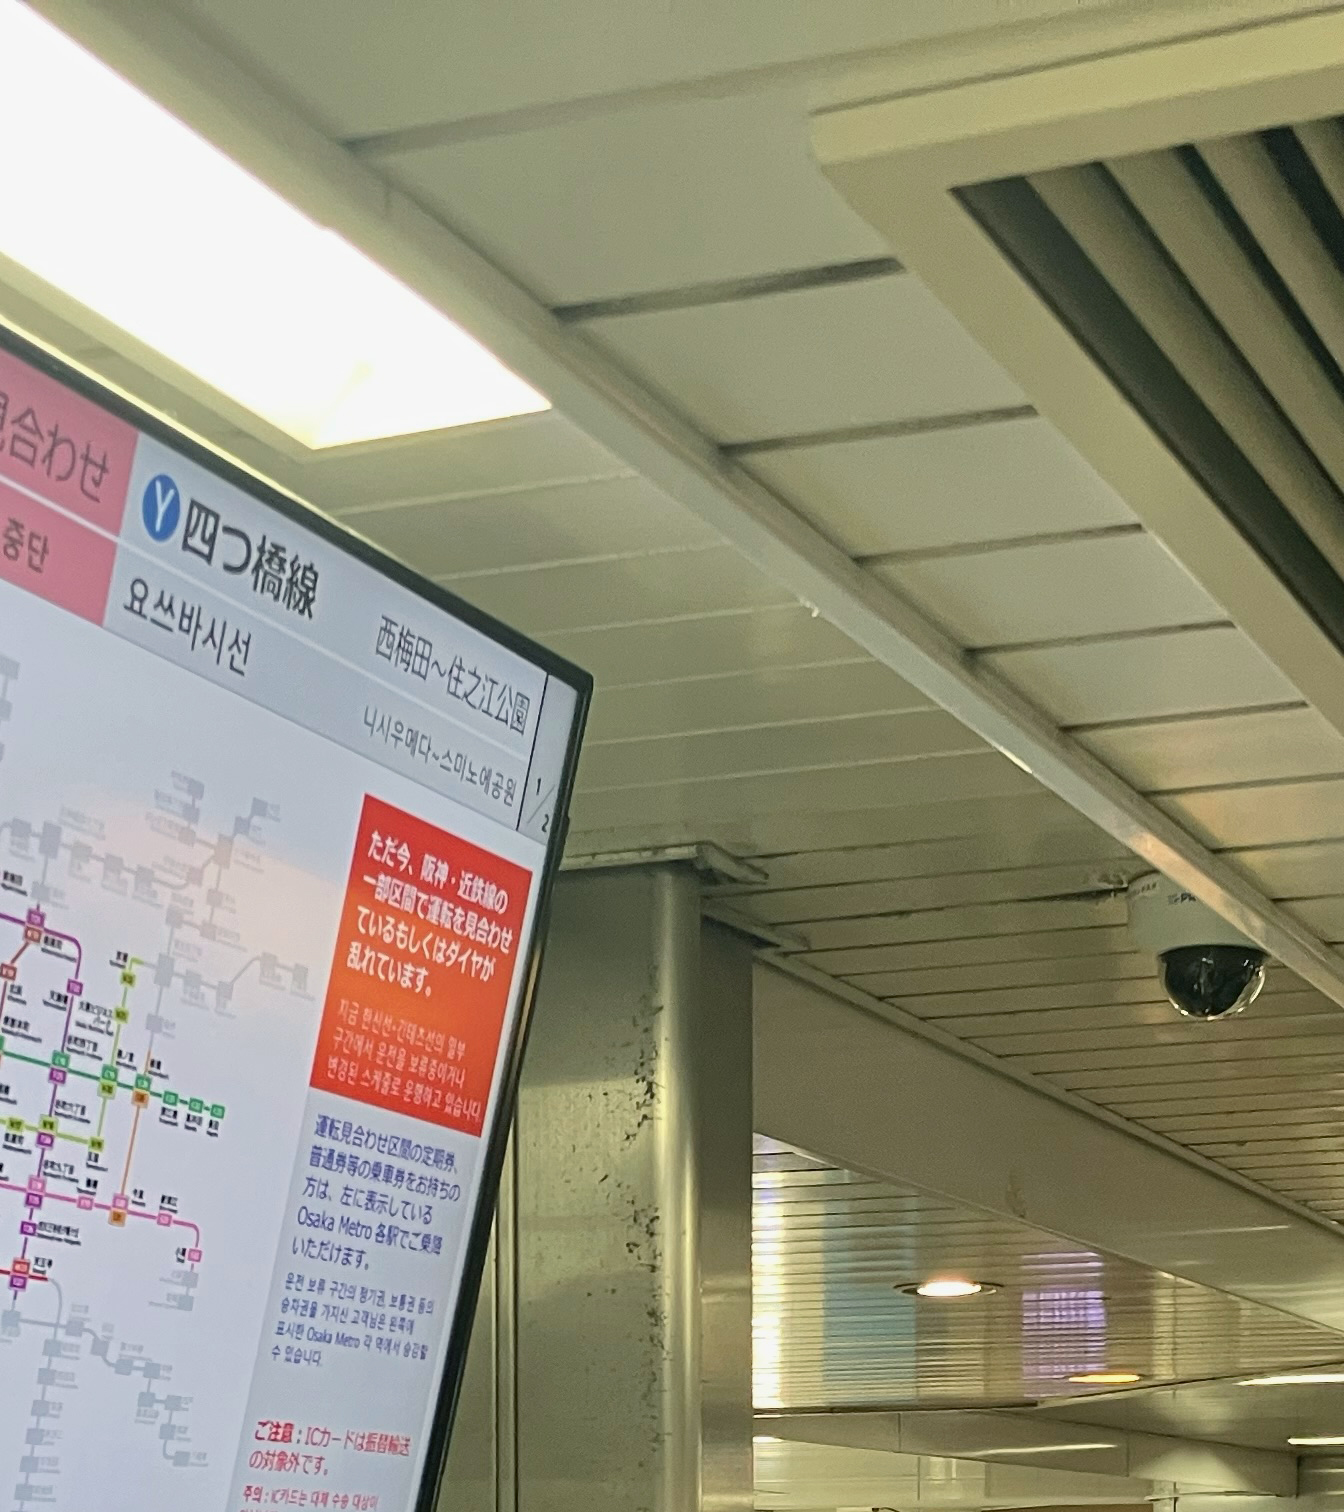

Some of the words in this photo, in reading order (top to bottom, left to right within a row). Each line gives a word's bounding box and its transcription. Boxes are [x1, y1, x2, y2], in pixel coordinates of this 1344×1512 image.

[2, 517, 49, 574] 중단
[181, 498, 319, 620] 四つ橋線
[123, 578, 252, 677] 요쓰바시선
[297, 1206, 335, 1232] Osaka
[338, 1215, 373, 1240] Metro
[292, 1236, 369, 1271] いただけます。
